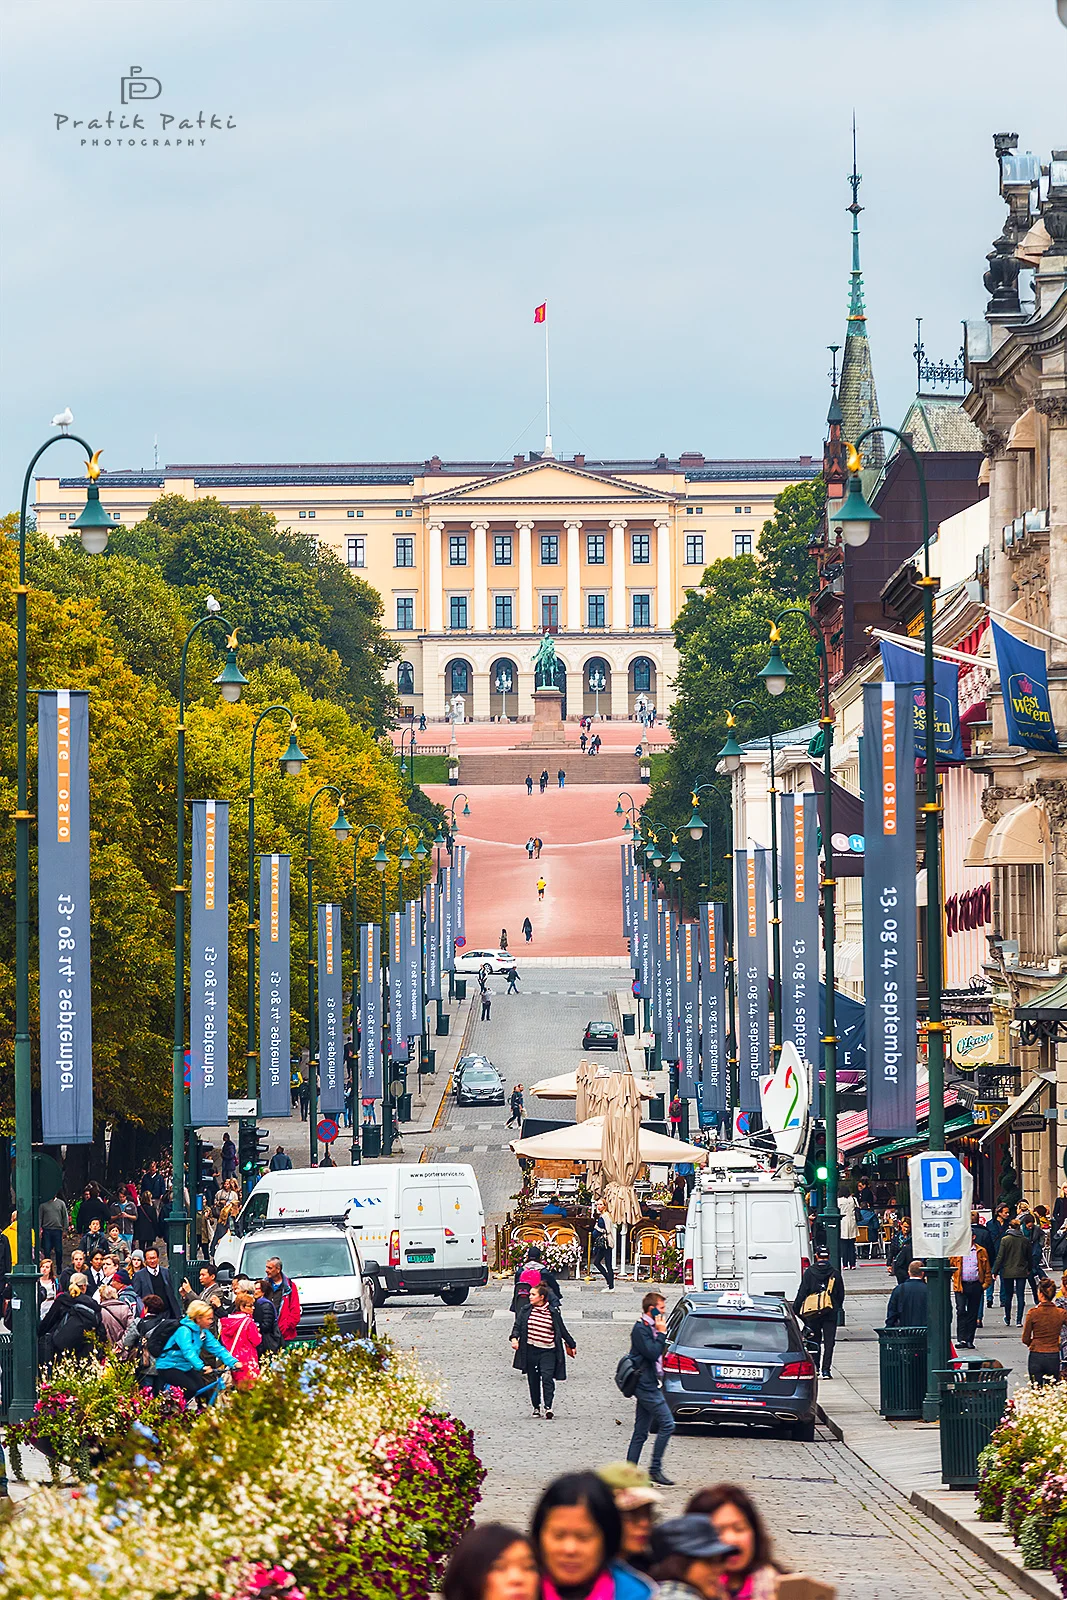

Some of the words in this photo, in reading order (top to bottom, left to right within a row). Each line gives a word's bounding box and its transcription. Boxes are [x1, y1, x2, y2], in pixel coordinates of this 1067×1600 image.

[883, 708, 894, 753] VALG
[884, 782, 895, 830] OSLO
[795, 810, 803, 842] VALG
[796, 864, 804, 898] OSLO
[880, 886, 897, 913] 13.
[880, 919, 898, 943] og
[792, 939, 805, 958] 13.
[747, 966, 758, 982] 13.
[793, 962, 805, 980] og
[880, 948, 898, 976] 14.
[709, 996, 717, 1009] 13.
[748, 985, 758, 1000] og
[793, 984, 805, 1003] 14.
[709, 1010, 717, 1022] og
[748, 1002, 758, 1019] 14.
[709, 1024, 717, 1037] 14.
[880, 981, 902, 1084] september
[709, 1039, 719, 1087] september
[748, 1021, 761, 1082] september
[930, 1162, 954, 1197] P
